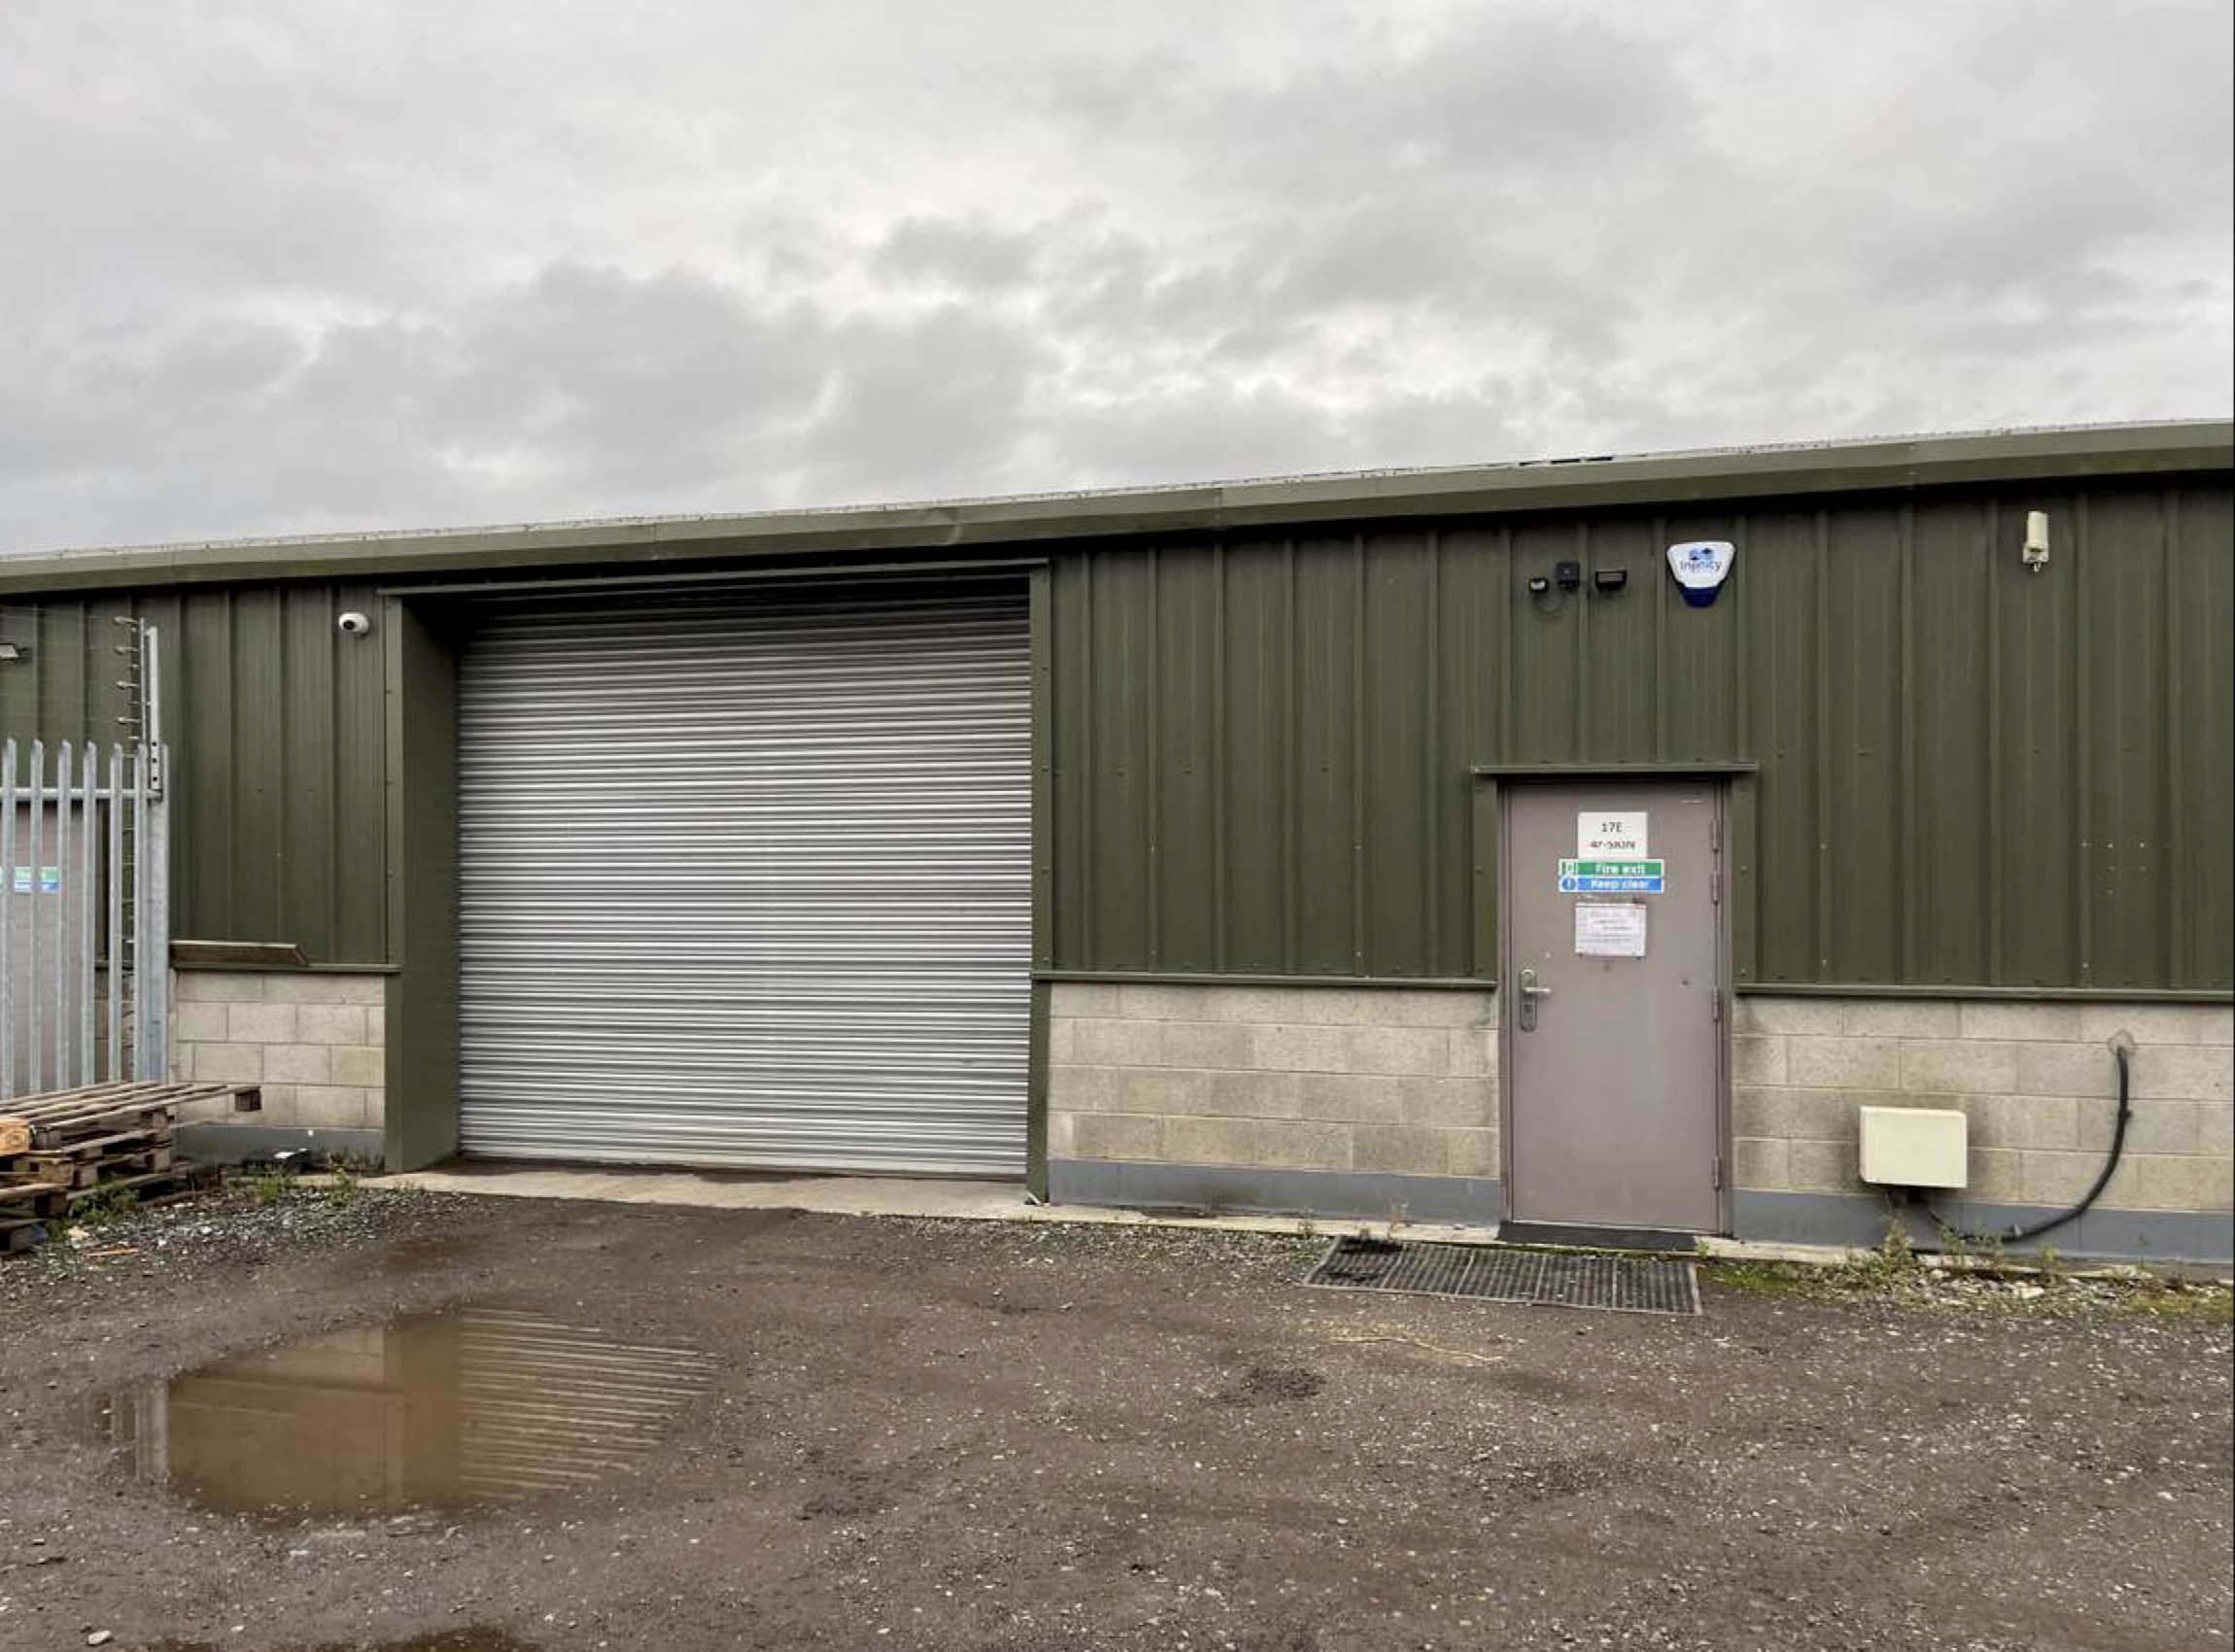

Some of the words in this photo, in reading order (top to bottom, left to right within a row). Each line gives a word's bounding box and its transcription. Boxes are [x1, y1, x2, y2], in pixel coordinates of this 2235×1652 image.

[1601, 822, 1623, 833] 17E
[1596, 863, 1620, 874] Fire
[1622, 863, 1645, 874] exit
[1590, 879, 1620, 891] Keep
[1622, 879, 1649, 889] clear
